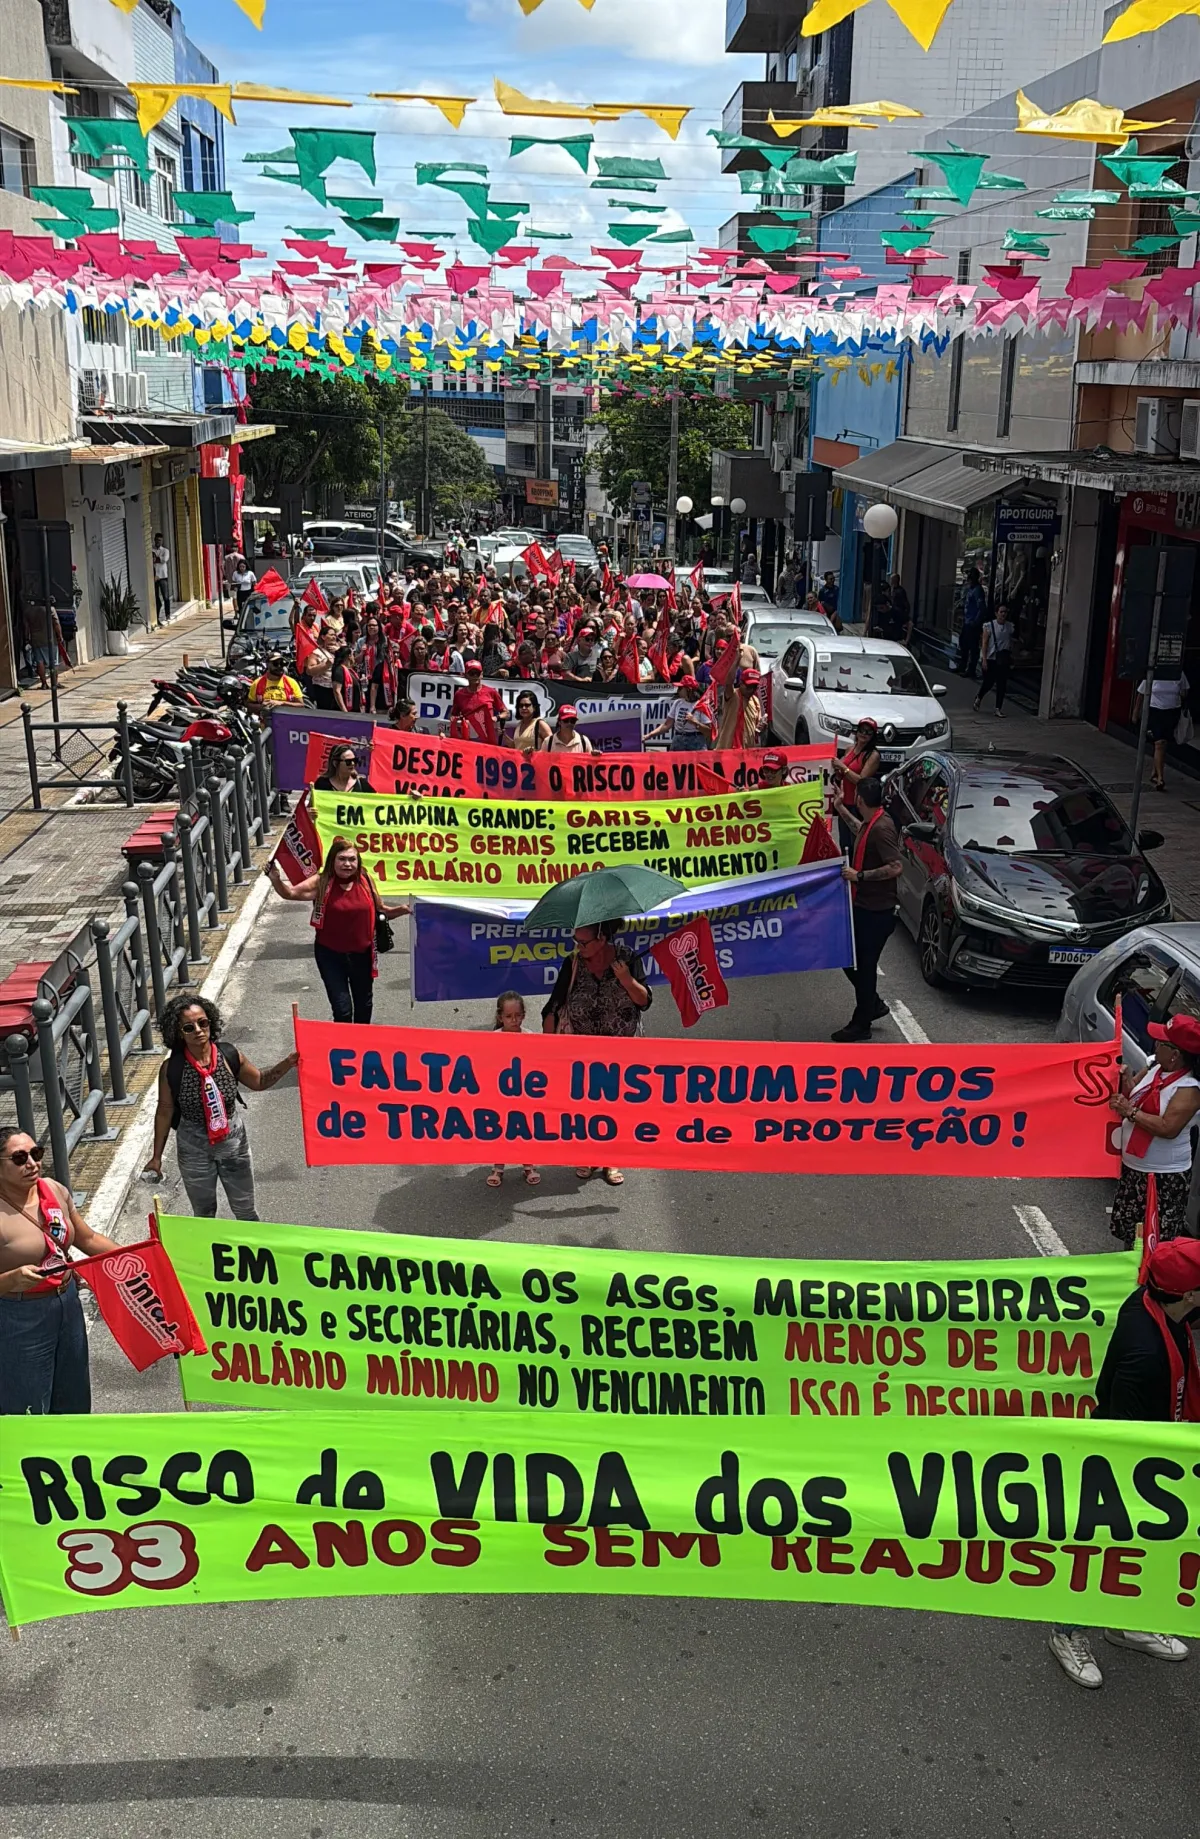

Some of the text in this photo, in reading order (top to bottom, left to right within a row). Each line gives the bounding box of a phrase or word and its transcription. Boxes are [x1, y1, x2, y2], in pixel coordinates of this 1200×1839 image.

[1000, 508, 1054, 520] APOTIGUAR
[393, 744, 464, 780] DESDE
[476, 756, 537, 791] 1992
[550, 766, 562, 792] O
[573, 764, 635, 792] RISCO
[643, 765, 669, 791] de
[336, 800, 762, 831] EM CAMPINA GRANDE: GARIS, VIGIAS
[356, 822, 772, 856] SERVIÇOS GERAIS RECEBEM MENOS
[374, 860, 386, 882] 1
[396, 857, 502, 884] SALÁRIO
[748, 893, 798, 915] LIMA
[490, 942, 580, 964] PAGU
[669, 932, 716, 1001] Sintab
[329, 1048, 996, 1104] FALTA de INSTRUMENTOS
[316, 1101, 366, 1139] de
[379, 1103, 618, 1142] TRABALHO
[634, 1119, 660, 1143] e
[676, 1118, 732, 1144] de
[210, 1242, 1106, 1327] EM CAMPINA OS ASGs, MERENDEIRAS,
[204, 1292, 1093, 1378] VIGIAS e SECRETÁRIAS, RECEBEM MENOS DE UM
[210, 1340, 347, 1390] SALÁRIO
[366, 1349, 500, 1404] MÍNIMO
[518, 1363, 559, 1408] NO
[572, 1368, 766, 1415] VENCIMENTO
[20, 1448, 256, 1526] RISCO
[429, 1450, 651, 1531] VIDA
[695, 1449, 853, 1537] dos
[57, 1519, 201, 1597] 33
[244, 1518, 482, 1573] ANOS
[542, 1523, 721, 1569] SEM
